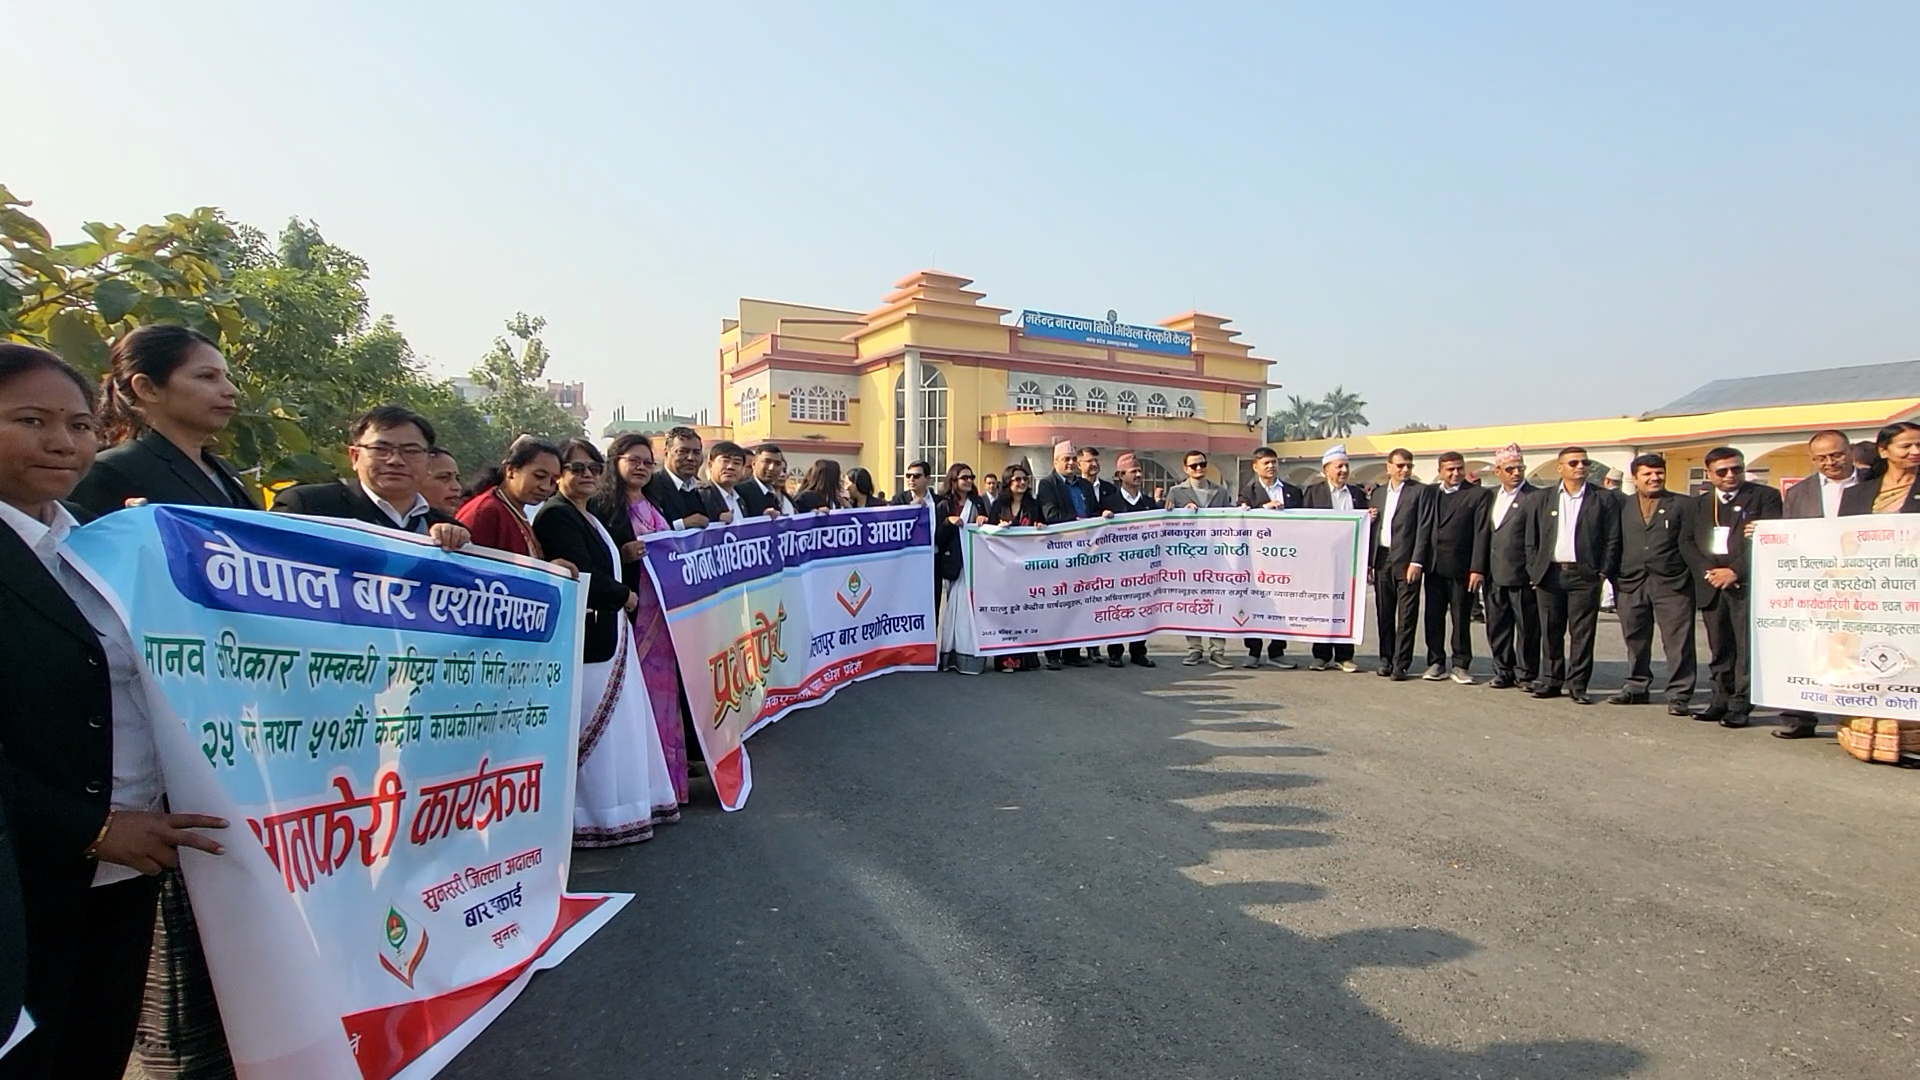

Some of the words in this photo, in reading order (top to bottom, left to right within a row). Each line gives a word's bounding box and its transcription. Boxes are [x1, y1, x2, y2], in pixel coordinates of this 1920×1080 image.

[1025, 312, 1054, 328] महेन्द्र
[1055, 318, 1092, 332] नारायण
[1093, 320, 1112, 335] निधि
[1114, 322, 1143, 339] मिथिला
[1143, 329, 1172, 344] संस्कृति
[1172, 332, 1191, 347] केन्द्र
[1046, 540, 1073, 550] नेपाल
[1076, 539, 1091, 549] बार
[1141, 530, 1158, 542] द्वारा
[1159, 528, 1206, 539] जनकपुरमा
[1210, 527, 1252, 538] आयोजना
[1256, 527, 1272, 540] हुने
[1024, 558, 1059, 571] मानव
[1065, 551, 1112, 568] अधिकार
[1118, 544, 1161, 562] सम्बन्धी
[1165, 542, 1208, 559] राष्ट्रिय
[1214, 542, 1249, 556] गोष्ठी
[1800, 556, 1838, 569] जिल्लाको
[1840, 557, 1891, 571] जनकपुरमा
[1894, 554, 1918, 569] मिति
[204, 531, 339, 609] नेपाल
[353, 571, 421, 620] बार
[429, 578, 550, 634] एशोसिएसन
[1029, 586, 1046, 599] ५१
[1073, 577, 1115, 593] केन्द्रीय
[1120, 568, 1186, 588] कार्यकारिणी
[1193, 568, 1251, 585] परिषद्को
[1257, 569, 1291, 585] बैठक
[1775, 578, 1810, 590] सम्पन्न
[1832, 575, 1877, 591] गइरहेको
[1880, 576, 1917, 591] नेपाल
[1094, 604, 1136, 623] हार्दिक
[1139, 600, 1174, 618] स्वागत
[1176, 598, 1215, 616] गर्दछौं
[1797, 597, 1850, 611] कार्यकारिणी
[1853, 598, 1879, 611] बैठक
[1904, 601, 1920, 612] मा
[839, 626, 859, 646] बार
[861, 613, 926, 641] एशोसिएशन
[144, 635, 205, 677] मानव
[309, 644, 380, 688] सम्बन्धी
[388, 646, 438, 696] राष्ट्रिय
[443, 651, 476, 686] गोष्ठी
[482, 651, 507, 686] मिति
[1801, 691, 1828, 703] धरान
[1834, 694, 1878, 707] सुनसरी
[1885, 696, 1918, 710] कोशी
[203, 721, 234, 768] २५
[263, 720, 303, 756] तथा
[375, 706, 424, 748] केन्द्रीय
[430, 702, 498, 740] कार्यकारिणी
[526, 697, 549, 728] बैठक
[247, 770, 406, 894] भातफेरी
[411, 757, 543, 845] कार्यक्रम
[422, 873, 468, 912] सुनसरी
[465, 867, 502, 890] जिल्ला
[505, 848, 543, 876] अदालत
[464, 902, 494, 928] बार
